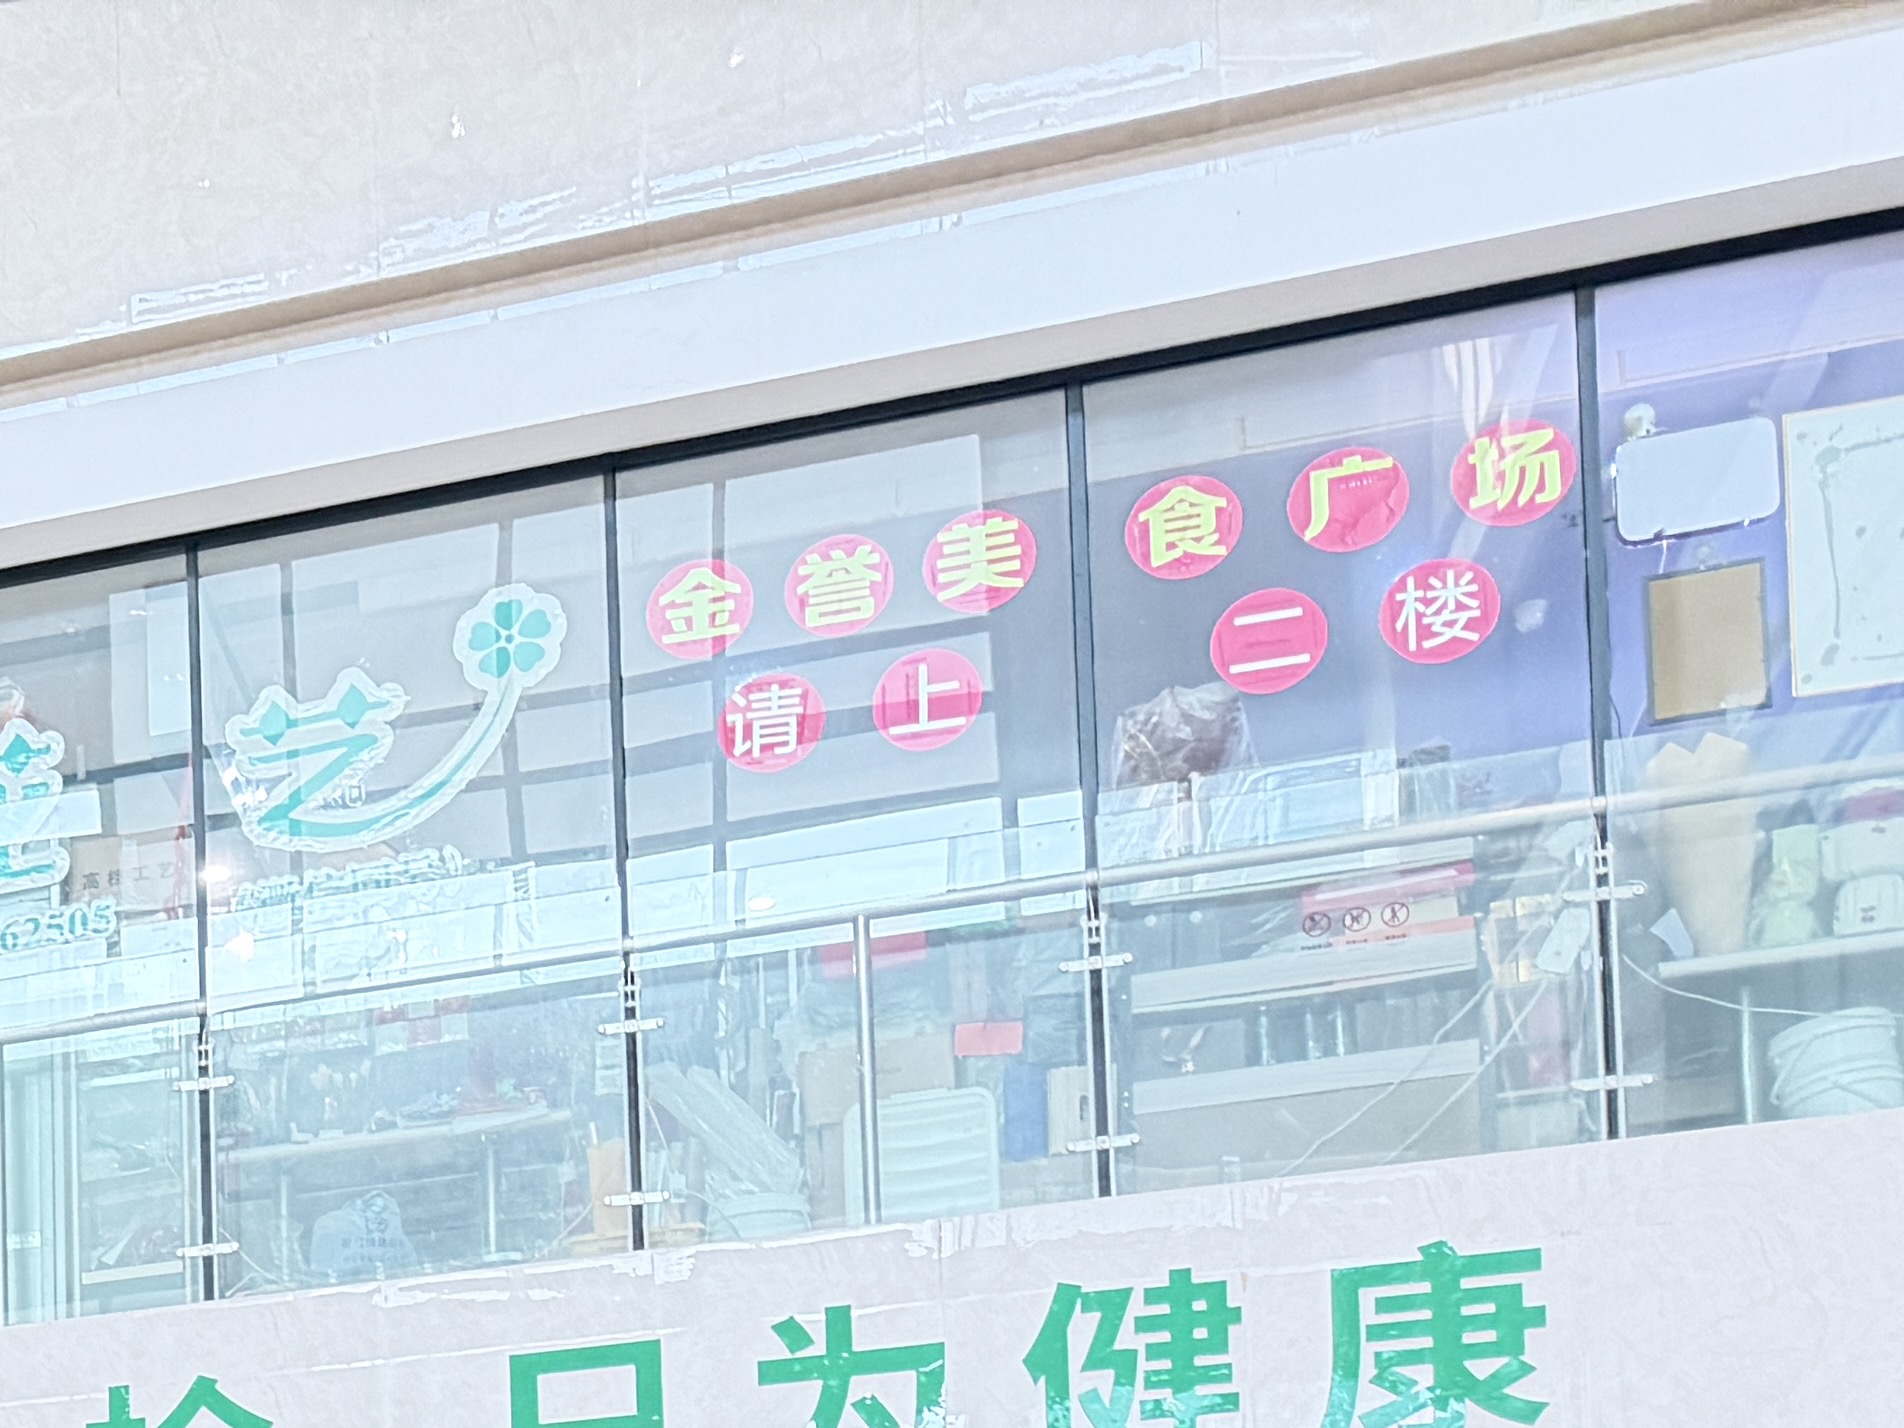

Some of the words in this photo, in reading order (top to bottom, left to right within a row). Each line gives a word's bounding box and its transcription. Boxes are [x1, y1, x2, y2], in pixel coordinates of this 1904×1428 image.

[657, 422, 1564, 645] 金誉美食广场
[728, 577, 1482, 758] 请上二楼
